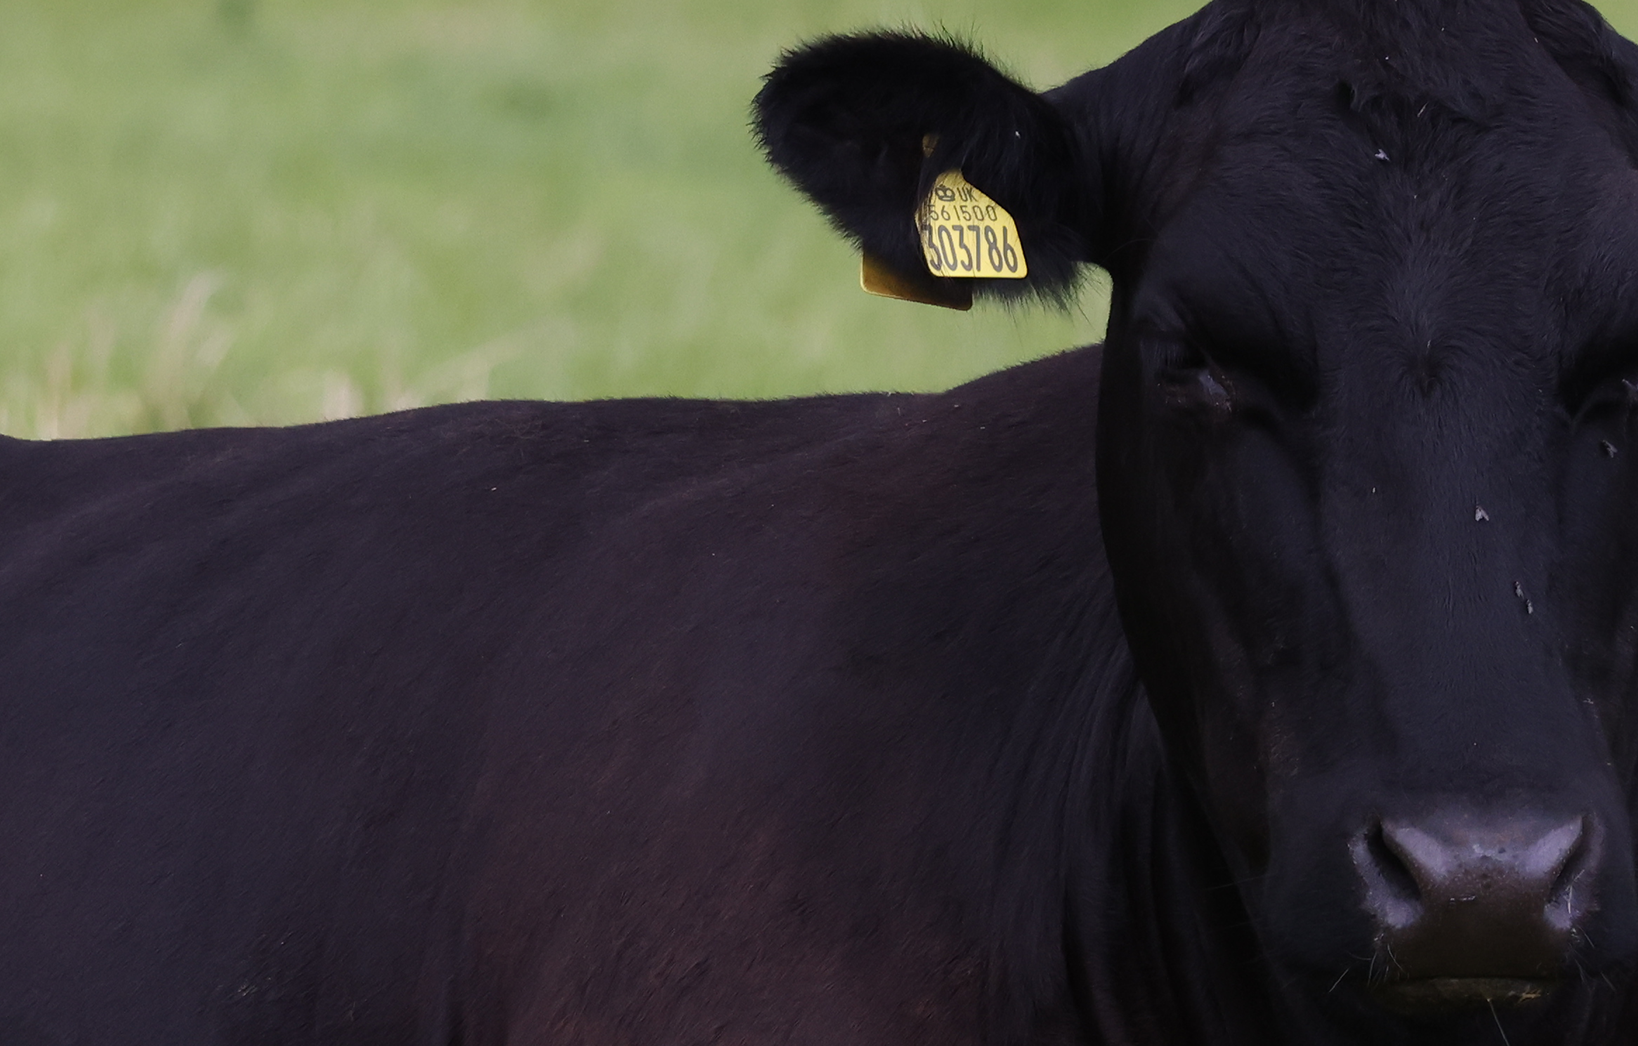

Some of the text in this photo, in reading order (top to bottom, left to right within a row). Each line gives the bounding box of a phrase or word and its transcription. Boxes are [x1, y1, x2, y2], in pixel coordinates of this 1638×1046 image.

[957, 187, 977, 202] UK
[928, 205, 998, 222] 561500
[922, 225, 1018, 273] 303786
